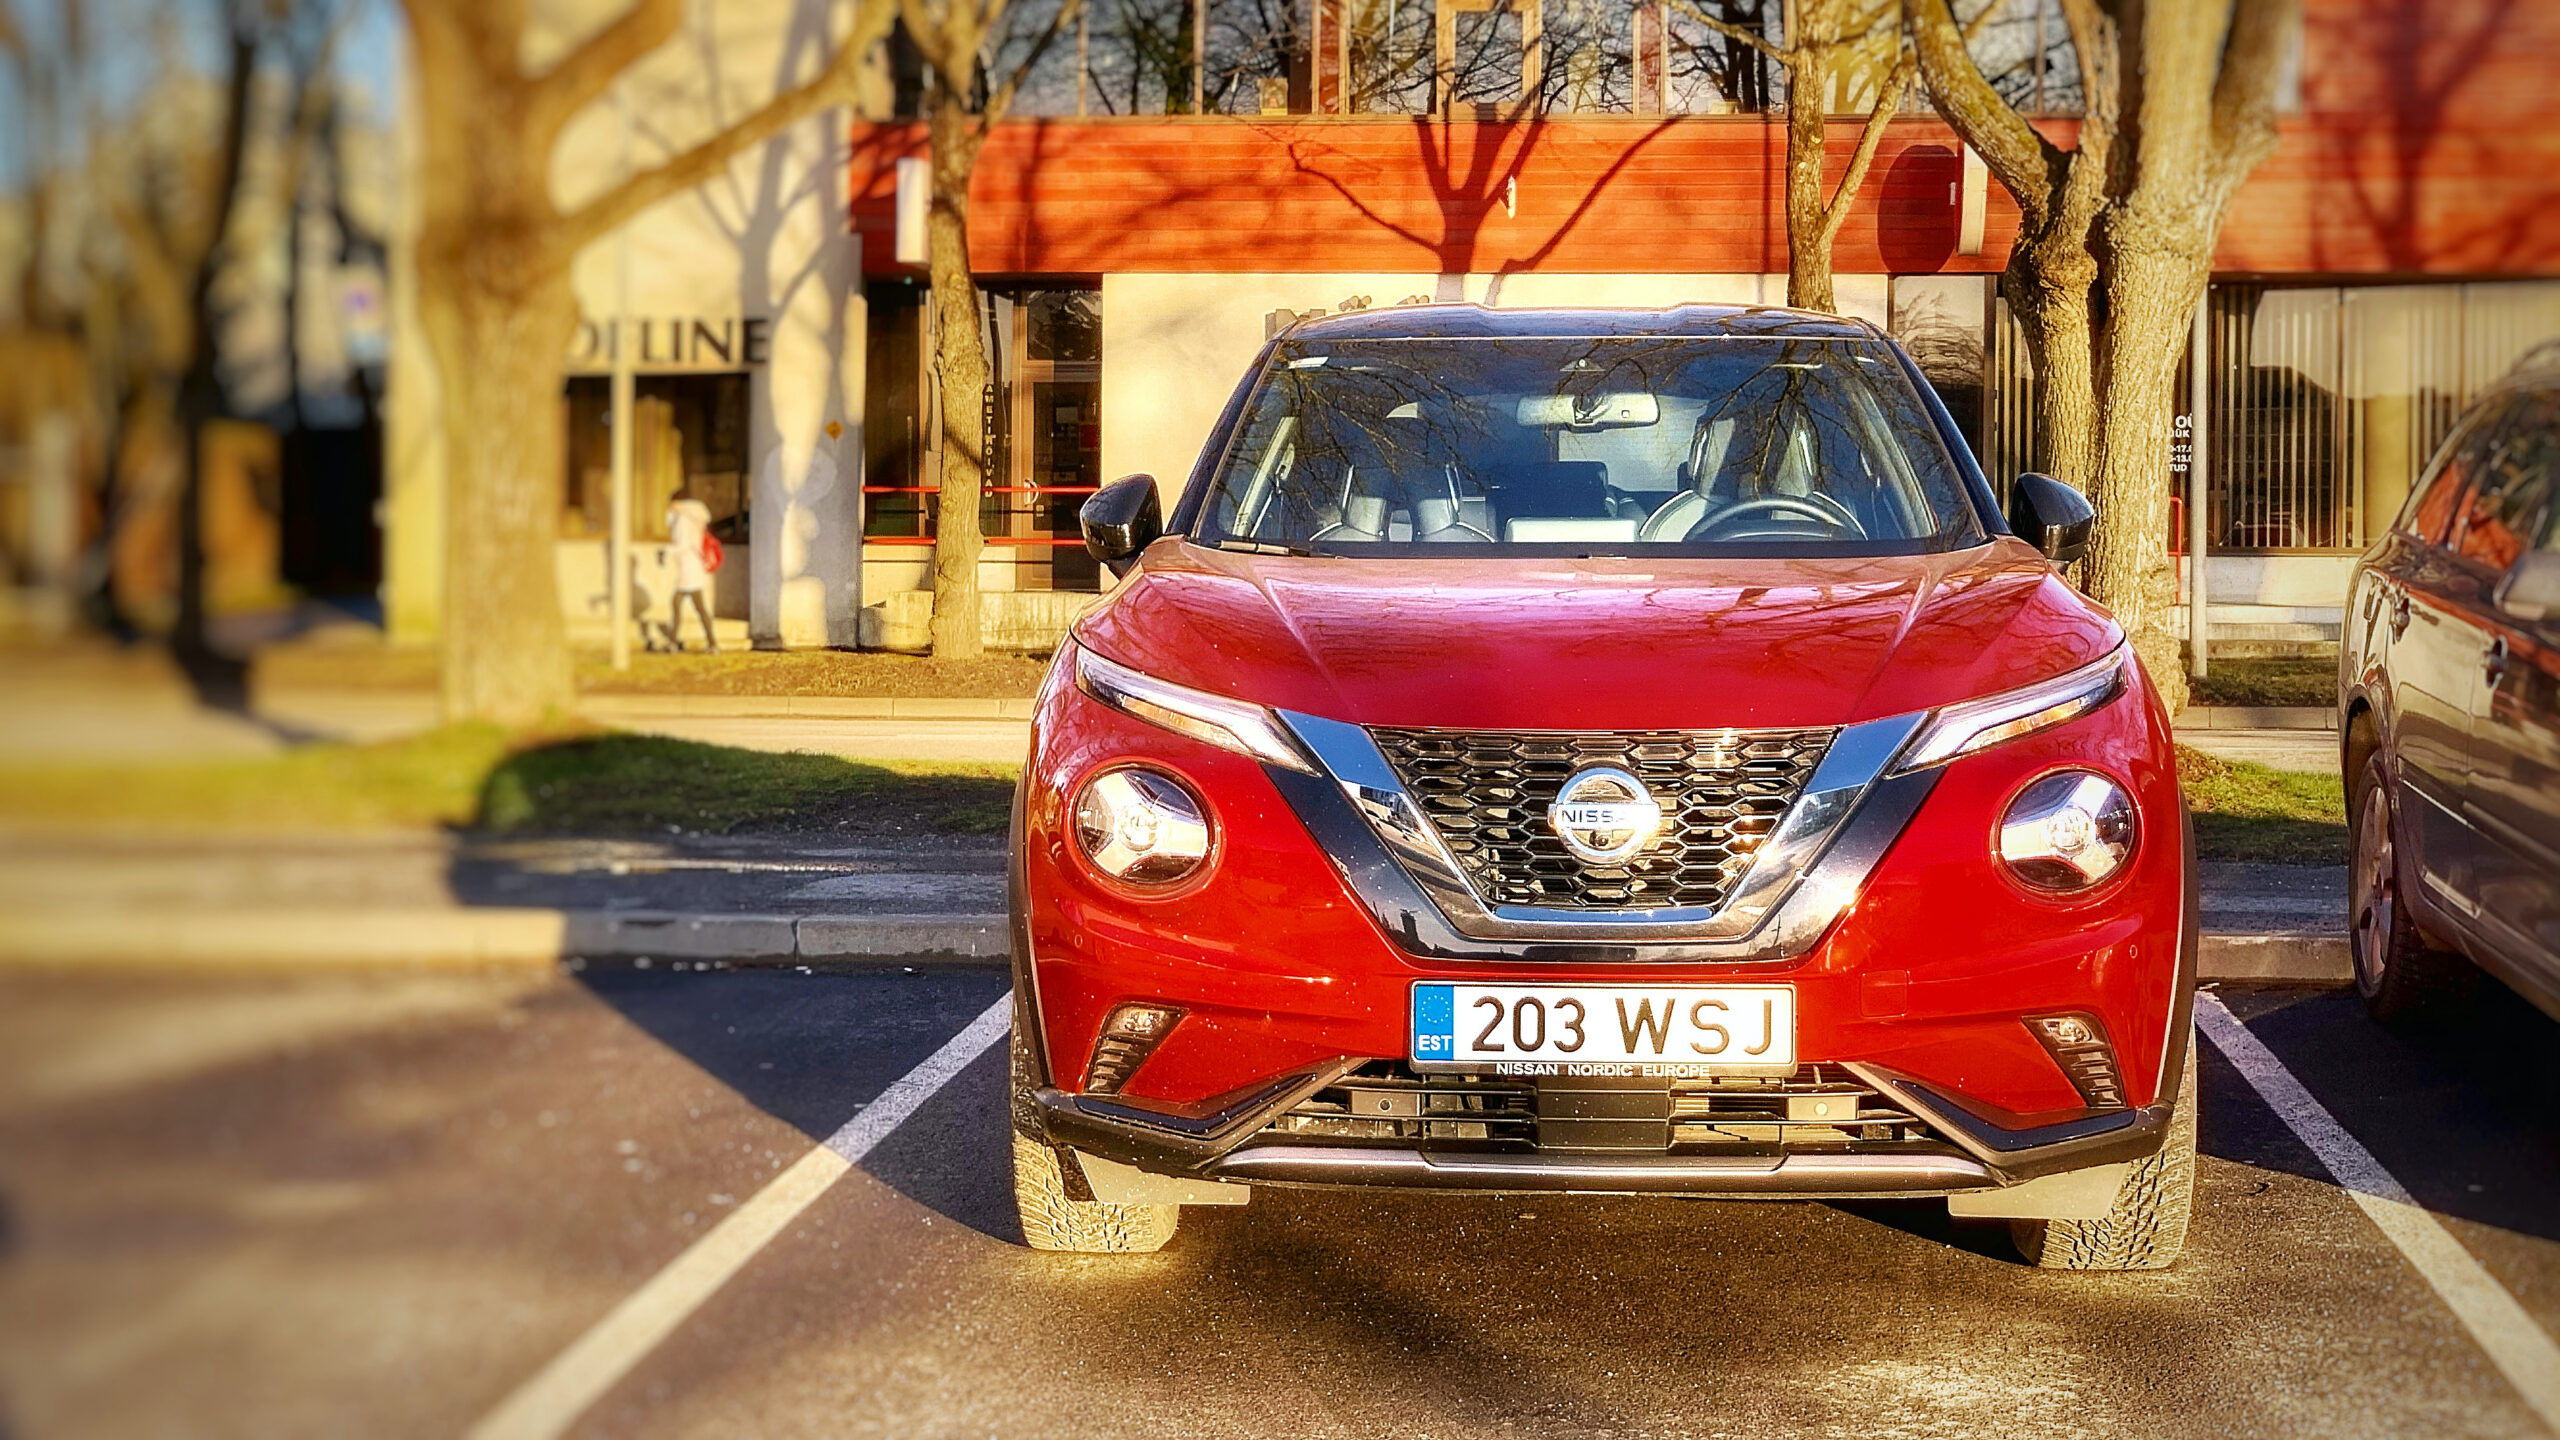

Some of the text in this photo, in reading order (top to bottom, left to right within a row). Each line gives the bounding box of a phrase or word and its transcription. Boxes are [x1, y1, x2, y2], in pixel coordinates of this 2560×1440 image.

[1472, 995, 1773, 1055] 203 WSJ
[1418, 1035, 1452, 1051] EST
[1496, 1063, 1710, 1077] NISSAN NORDIC EUROPE
